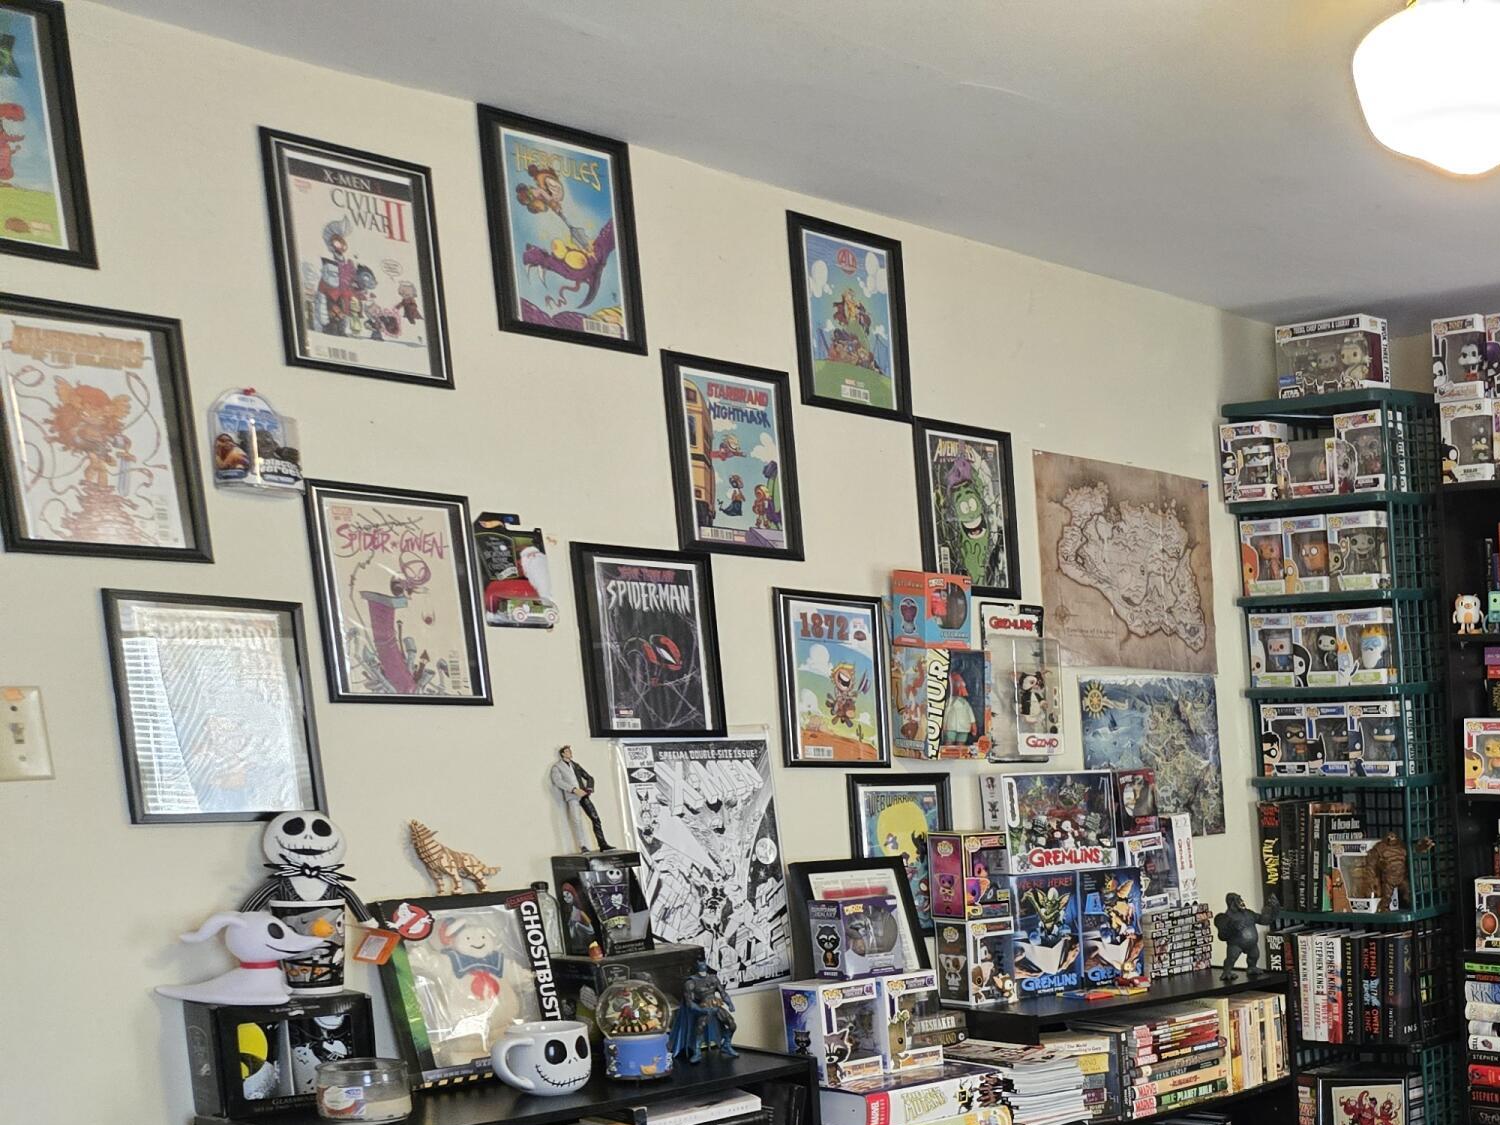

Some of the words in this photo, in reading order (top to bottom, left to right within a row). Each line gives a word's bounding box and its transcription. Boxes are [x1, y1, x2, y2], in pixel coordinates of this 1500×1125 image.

[322, 168, 371, 191] X-MEN
[515, 144, 603, 192] HERCULES
[330, 188, 384, 217] CIVIL
[384, 200, 409, 243] II
[350, 211, 390, 234] WAR
[709, 401, 771, 428] NIGHTMASK
[335, 524, 391, 553] SPIDER
[398, 533, 444, 560] GWEN
[607, 581, 691, 614] SPIDER-MAN
[800, 612, 849, 641] 1872
[989, 616, 1033, 632] GREMLINS
[1025, 735, 1058, 748] GIZMO
[659, 751, 689, 760] SPECIAL
[1029, 846, 1100, 868] GREMLINS
[1262, 837, 1279, 885] TALISMAN
[520, 900, 562, 1021] GHOSTBUST
[1315, 941, 1323, 971] STEPHEN
[1326, 941, 1335, 974] STEPHEN
[1021, 973, 1077, 991] GREMLINS
[1315, 972, 1323, 989] KING
[1372, 1009, 1380, 1034] OWEN
[1472, 1054, 1498, 1063] STEPHEN
[1472, 1091, 1499, 1103] STEPHEN
